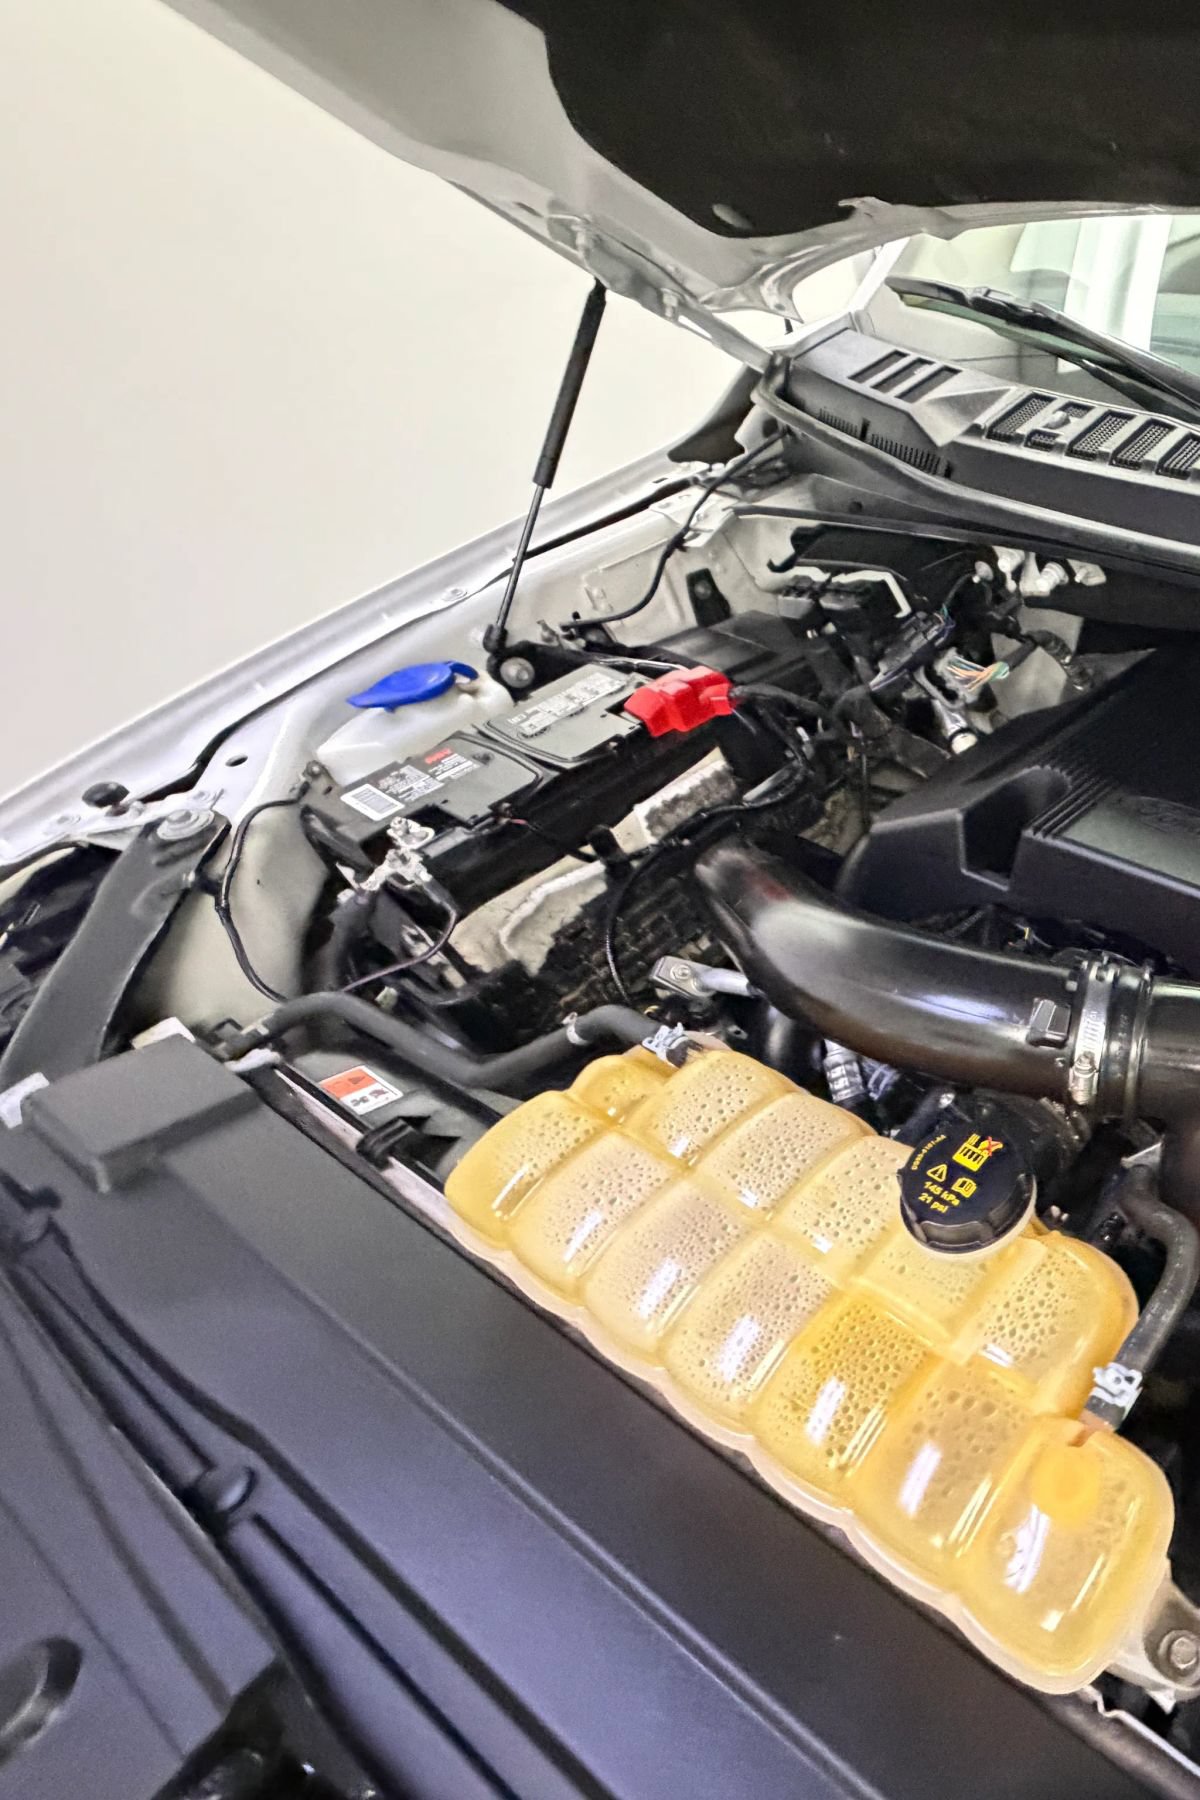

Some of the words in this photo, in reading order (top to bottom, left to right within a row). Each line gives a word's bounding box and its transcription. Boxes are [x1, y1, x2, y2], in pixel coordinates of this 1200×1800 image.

[918, 1192, 933, 1204] 21
[930, 1201, 949, 1213] psi
[924, 1181, 943, 1195] 145
[940, 1191, 960, 1206] kPa
